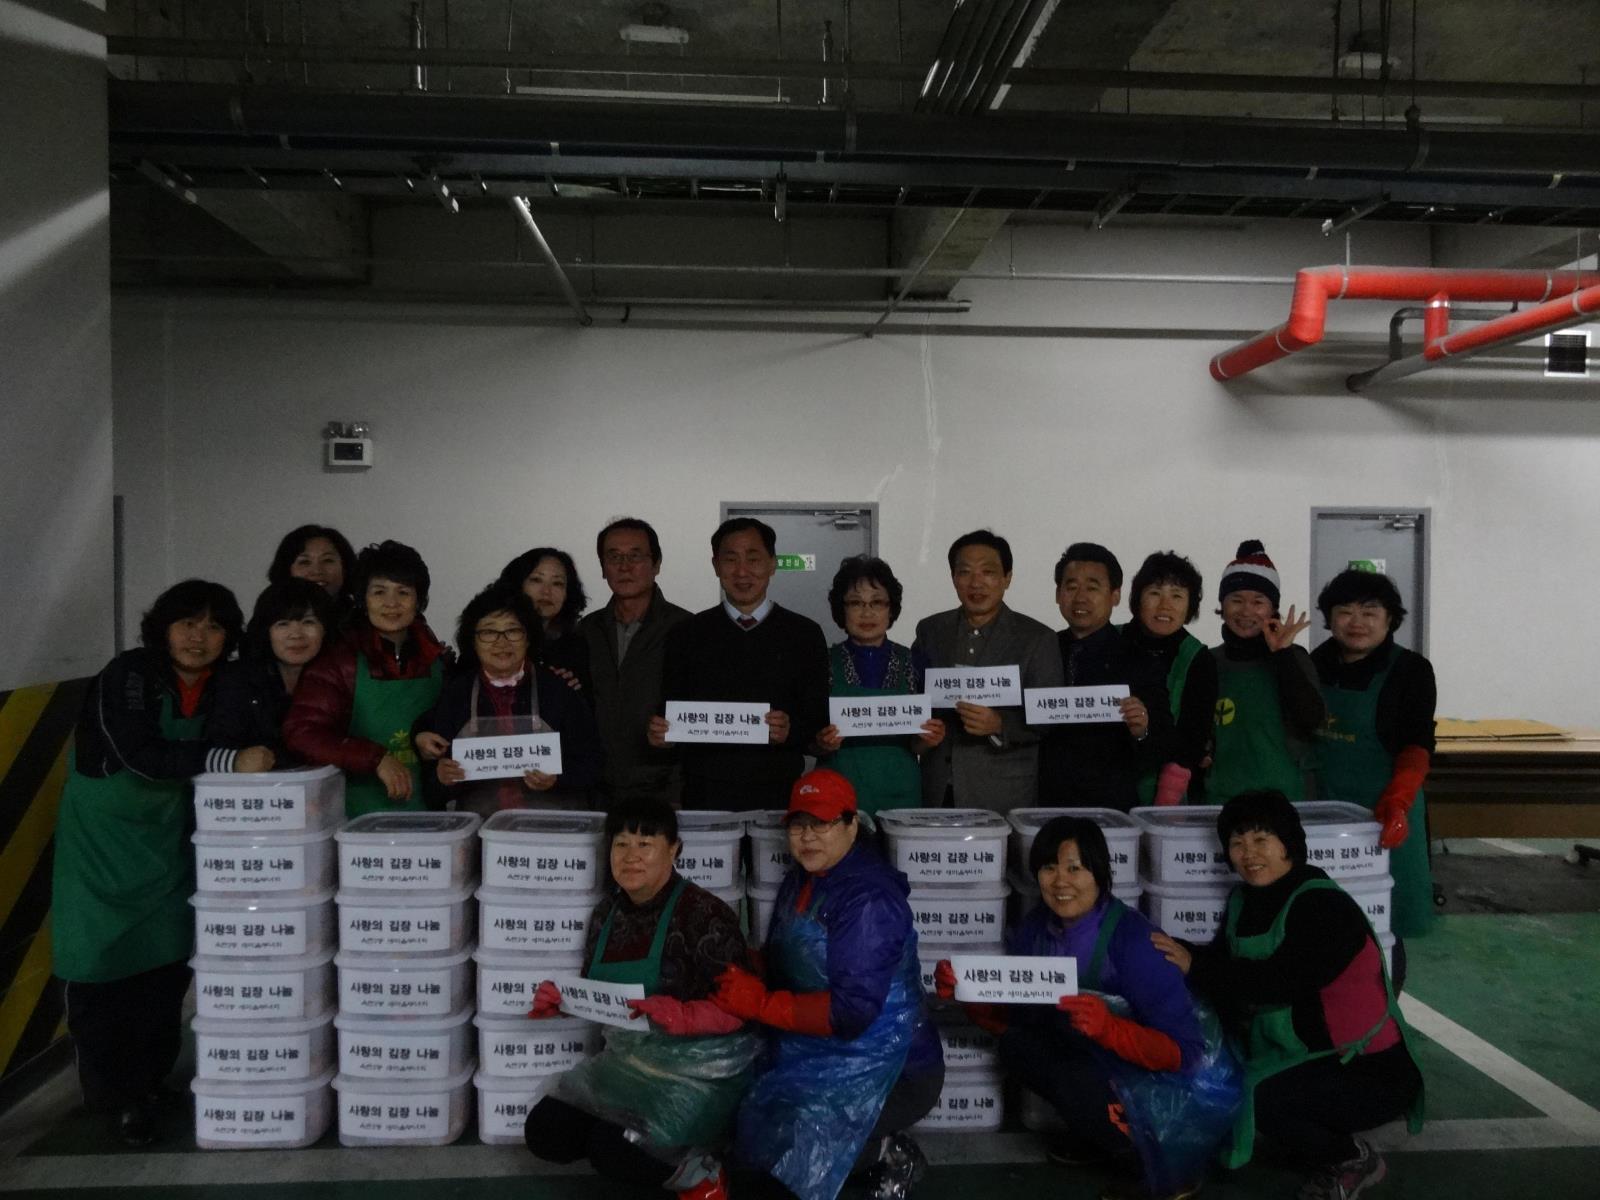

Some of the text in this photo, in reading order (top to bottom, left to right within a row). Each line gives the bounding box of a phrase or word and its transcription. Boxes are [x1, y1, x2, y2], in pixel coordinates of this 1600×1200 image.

[935, 677, 1010, 689] 사랑의 김장 나눔
[1037, 696, 1122, 709] 사랑의 김장 나눔
[841, 705, 922, 717] 사랑의 김장 나눔
[678, 712, 760, 724] 사랑의 김장 나눔
[464, 745, 551, 760] 사랑의 김장 나눔
[204, 798, 294, 810] 사랑의 김장 나눔
[909, 852, 994, 863] 사랑의 김장 나눔
[1109, 853, 1128, 864] 나눔
[1175, 853, 1206, 864] 사랑의
[1341, 848, 1359, 859] 김장
[1365, 846, 1382, 856] 나눔
[203, 859, 293, 871] 사랑의 김장 나눔
[351, 857, 441, 869] 사랑의 김장 나눔
[497, 856, 587, 870] 사랑의 김장 나눔
[676, 857, 723, 869] 김장 나눔
[1368, 905, 1384, 915] 나눔
[949, 913, 969, 924] 김장
[975, 913, 995, 923] 나눔
[1174, 912, 1206, 922] 사랑의
[205, 924, 295, 936] 사랑의 김장 나눔
[351, 920, 440, 932] 사랑의 김장 나눔
[494, 918, 584, 931] 사랑의 김장 나눔
[965, 969, 1065, 983] 사랑의 김장 나눔
[203, 986, 293, 998] 사랑의 김장 나눔
[351, 983, 440, 995] 사랑의 김장 나눔
[492, 983, 524, 994] 사랑의
[561, 986, 588, 999] 사랑의
[593, 992, 611, 1005] 김장
[208, 1049, 299, 1061] 사랑의 김장 나눔
[350, 1046, 439, 1060] 사랑의 김장 나눔
[494, 1044, 526, 1056] 사랑의
[534, 1043, 555, 1055] 김장
[495, 1103, 526, 1116] 사랑의
[949, 1097, 994, 1110] 김장 나눔
[204, 1109, 294, 1122] 사랑의 김장 나눔
[350, 1106, 439, 1118] 사랑의 김장 나눔
